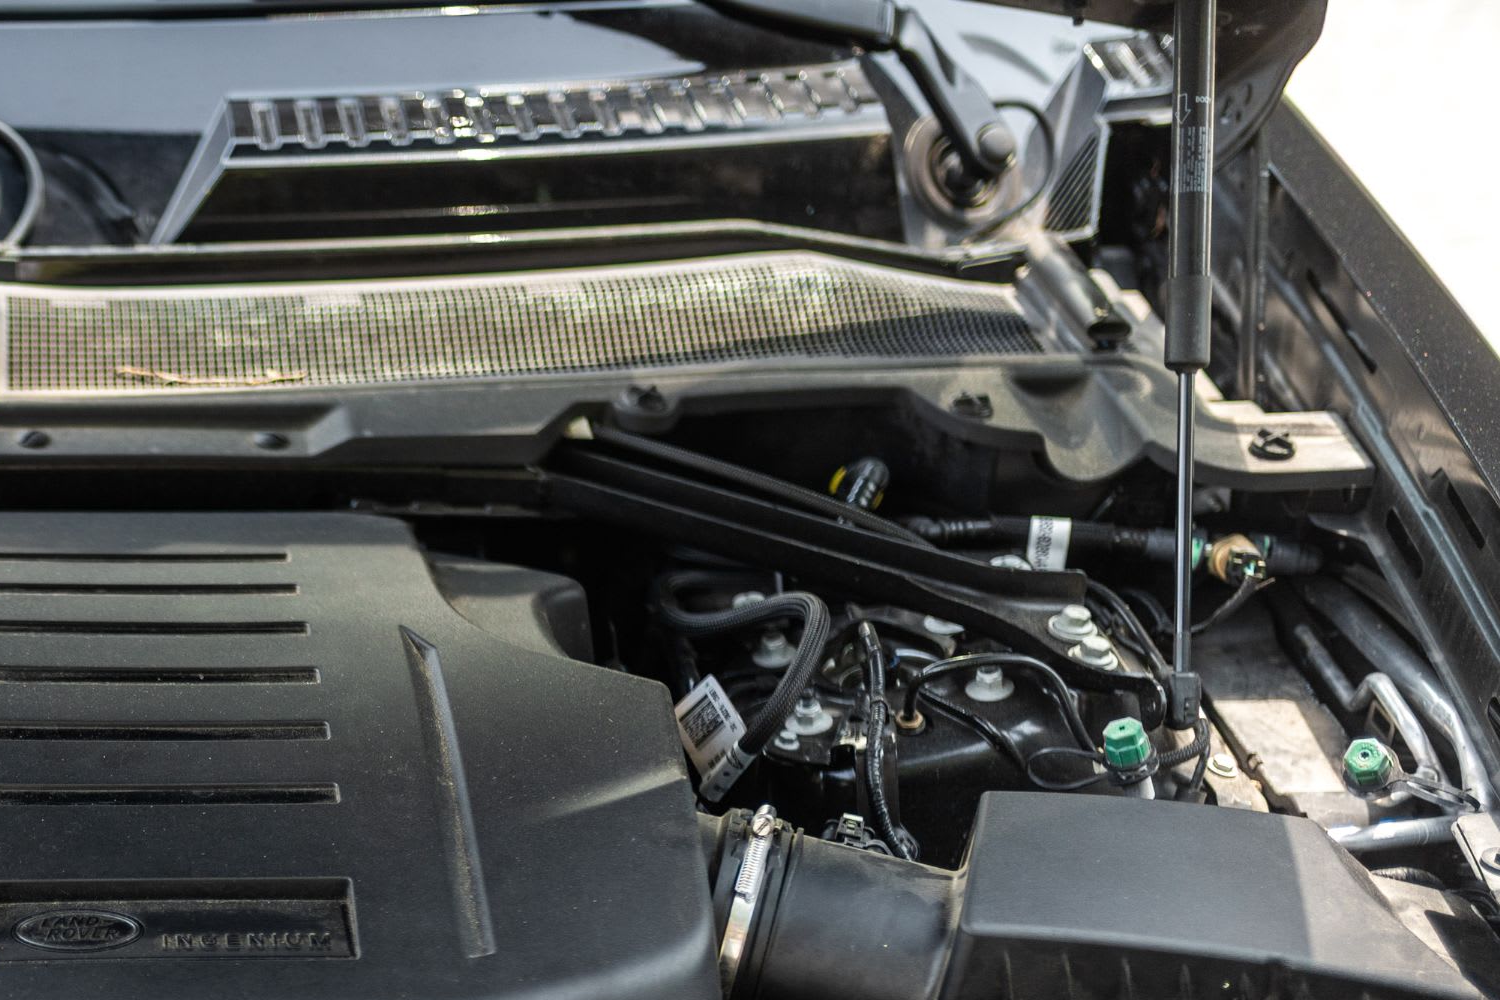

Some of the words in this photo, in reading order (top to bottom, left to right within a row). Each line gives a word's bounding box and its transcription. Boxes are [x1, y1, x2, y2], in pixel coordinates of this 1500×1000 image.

[40, 914, 102, 928] LAND
[46, 926, 122, 940] ROVER
[161, 932, 333, 951] INGENIUM
